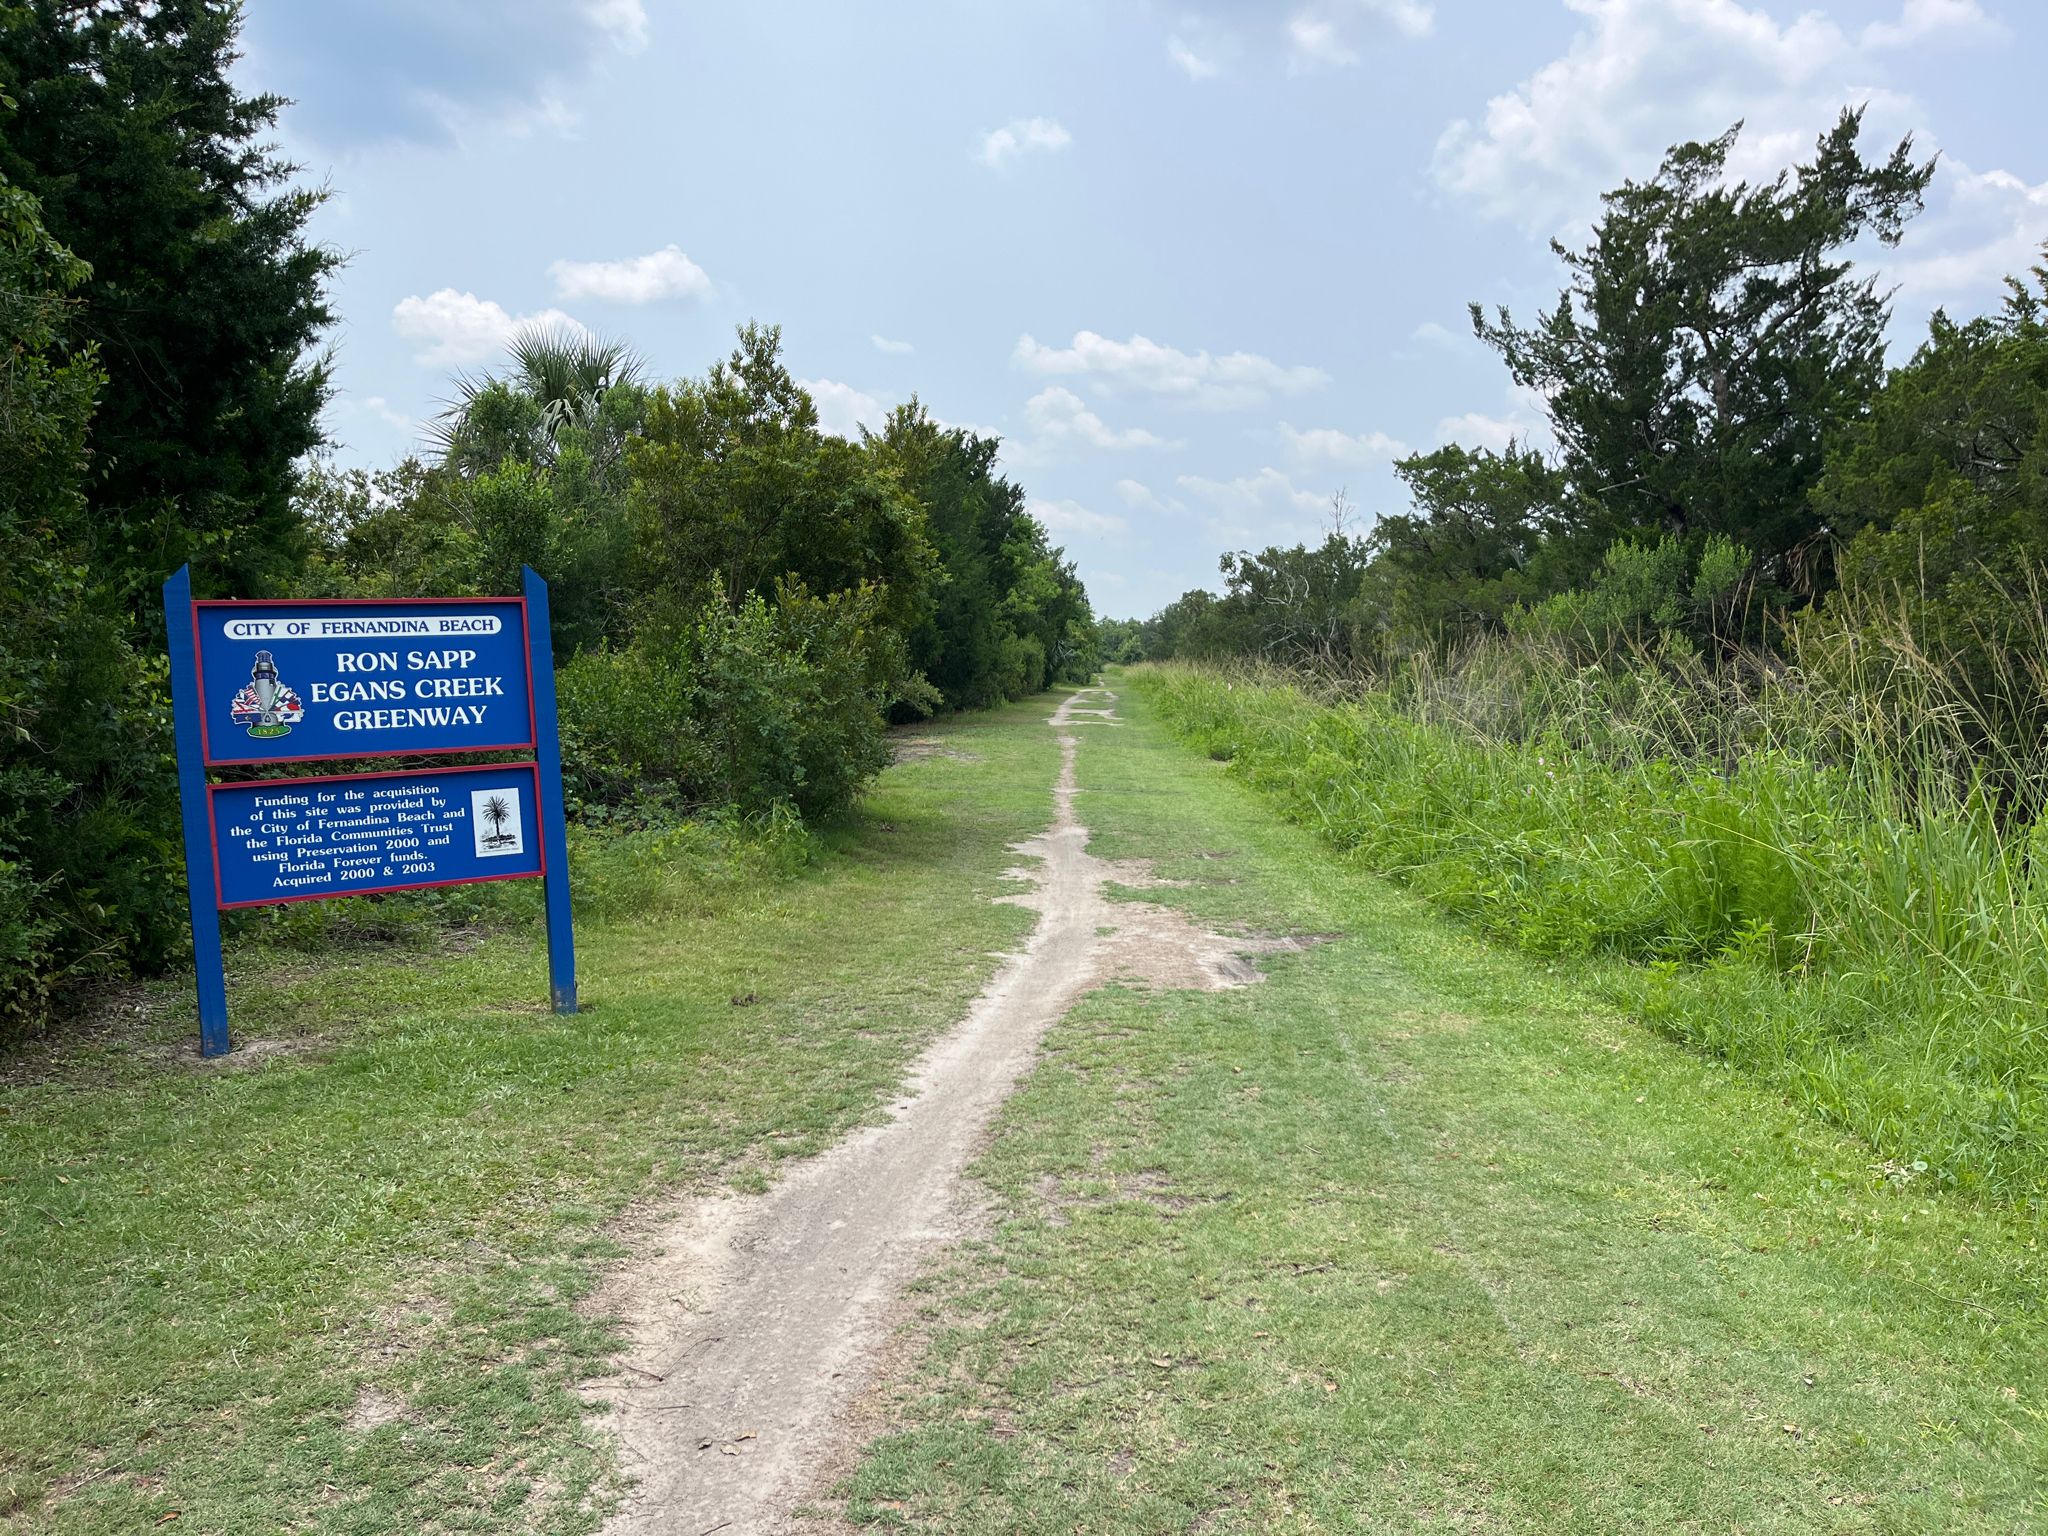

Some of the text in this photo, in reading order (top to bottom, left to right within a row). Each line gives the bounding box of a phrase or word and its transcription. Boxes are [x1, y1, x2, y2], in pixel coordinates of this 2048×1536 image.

[233, 619, 494, 636] CITY OF FERNANDINA BEACH
[337, 650, 476, 672] RON SAPP
[311, 677, 503, 702] EGANS CREEK
[333, 706, 487, 731] GREENWAY
[250, 796, 446, 821] of this site was provided by
[255, 785, 439, 809] Funding for the acquisition
[230, 808, 465, 836] the City of Fernandina Beach and
[246, 822, 453, 849] the Florida Communities Trust
[253, 835, 450, 863] using Preservation 2000 and
[279, 850, 428, 873] Florida Forever funds.
[273, 862, 435, 887] Acquired 2000 & 2003
